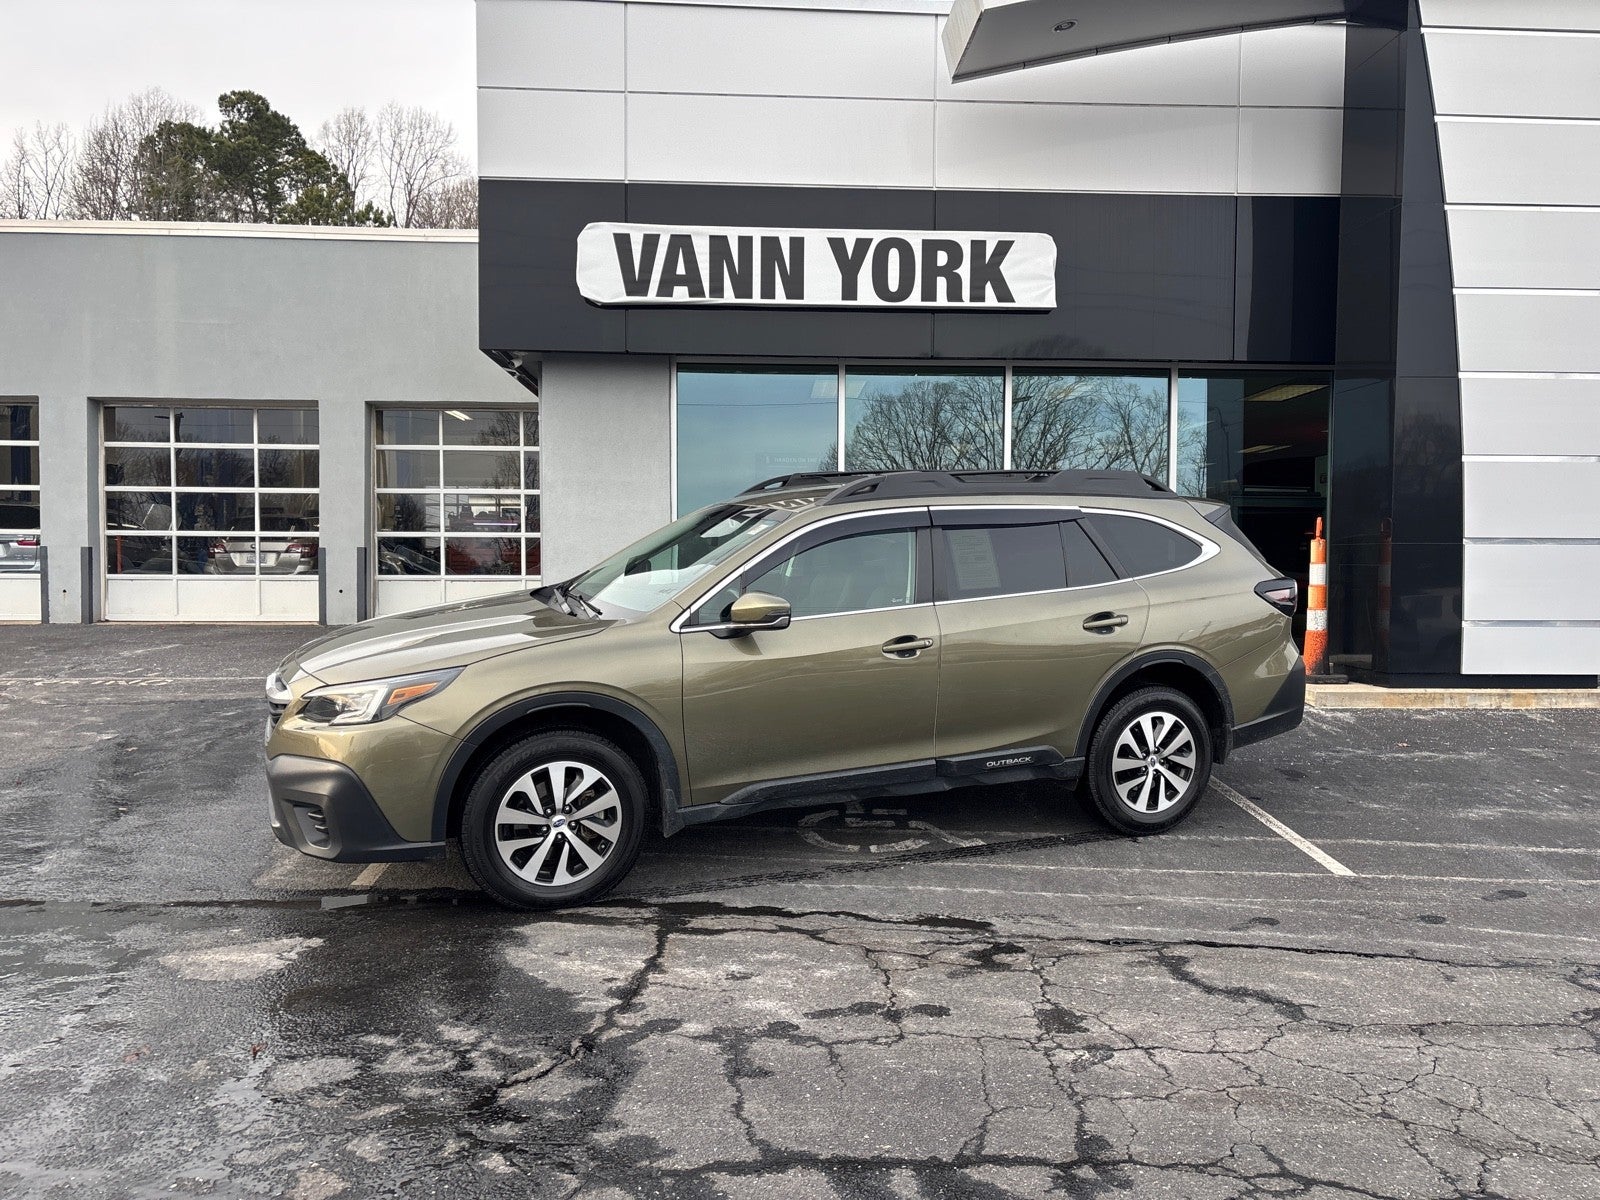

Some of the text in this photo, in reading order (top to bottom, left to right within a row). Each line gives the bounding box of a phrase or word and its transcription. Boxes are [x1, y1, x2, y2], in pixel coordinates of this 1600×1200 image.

[612, 232, 1017, 304] VANN YORK
[986, 756, 1032, 768] OUTBACK
